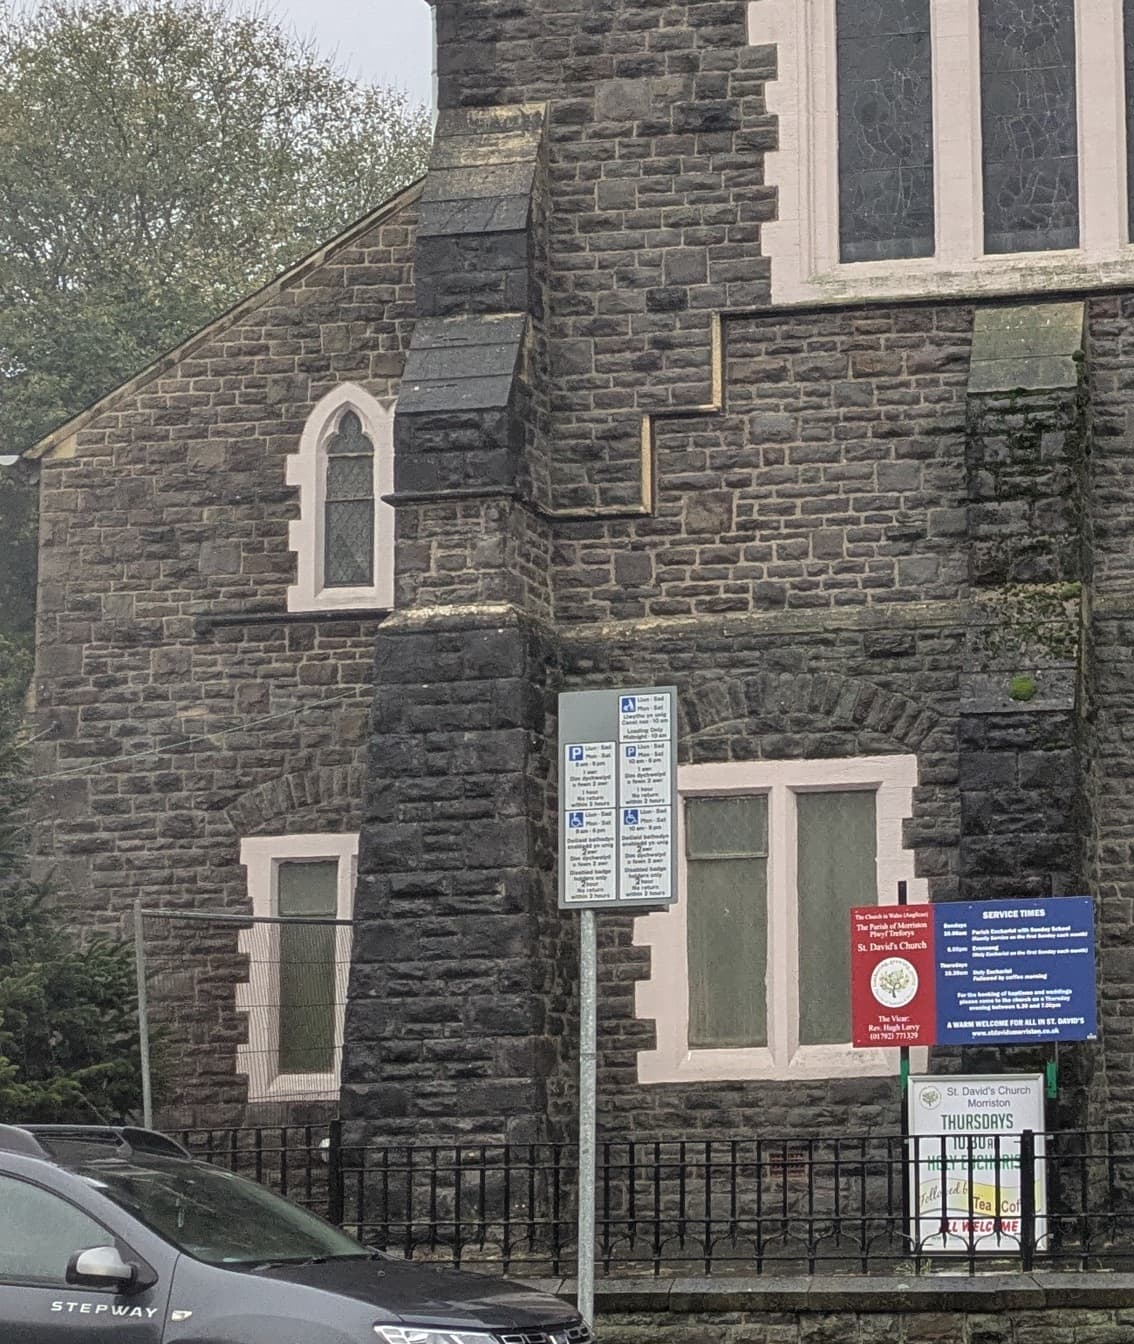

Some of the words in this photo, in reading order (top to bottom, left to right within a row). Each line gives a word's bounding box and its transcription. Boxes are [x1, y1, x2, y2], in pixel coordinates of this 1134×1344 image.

[983, 910, 1019, 919] SERVICE
[1020, 909, 1045, 917] TIMES
[870, 942, 898, 951] David's
[899, 941, 927, 949] Church
[947, 1087, 959, 1096] St.
[962, 1086, 995, 1096] David's
[998, 1086, 1031, 1095] Church
[968, 1099, 1010, 1107] Morriston
[941, 1114, 1014, 1130] THURSDAYS
[974, 1196, 992, 1211] Tea
[962, 1221, 1019, 1232] WELCME
[50, 1301, 158, 1318] STEPWAY
